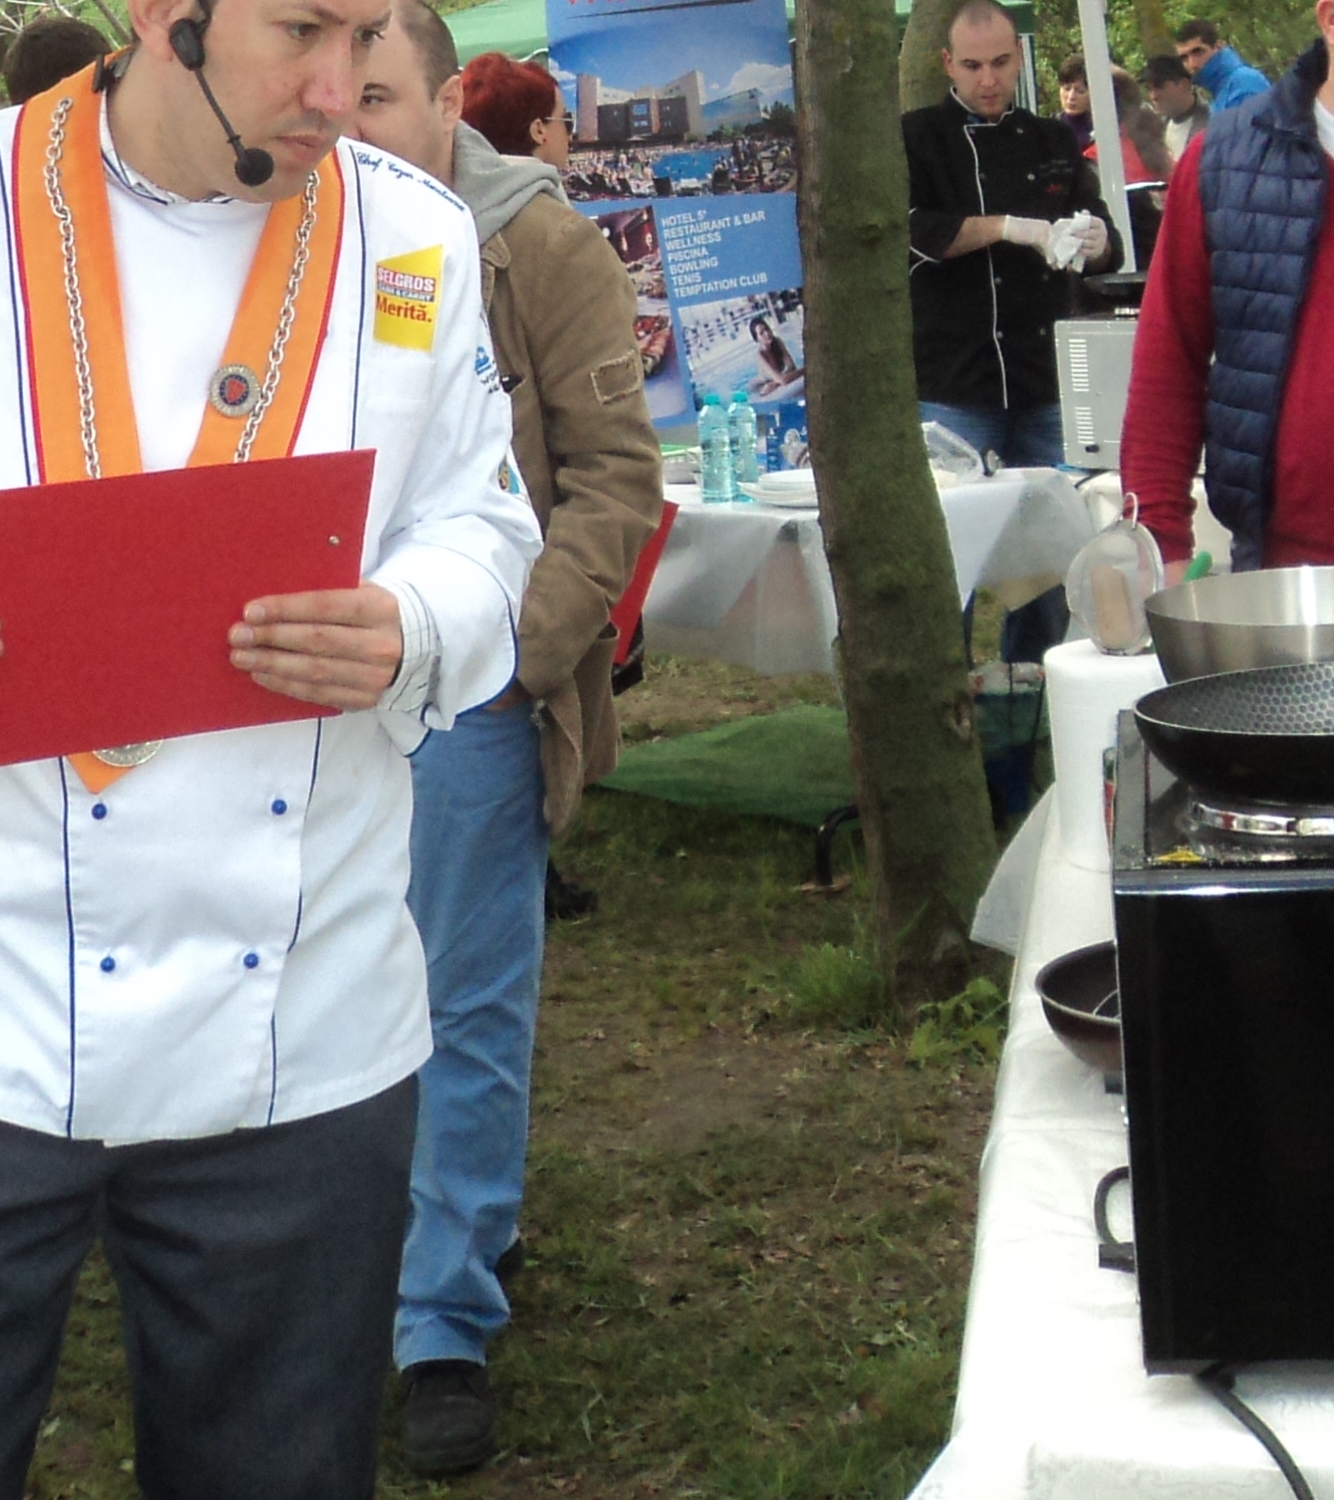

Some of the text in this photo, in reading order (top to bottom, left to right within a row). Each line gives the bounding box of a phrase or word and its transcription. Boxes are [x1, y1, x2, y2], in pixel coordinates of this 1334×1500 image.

[661, 212, 695, 227] HOTEL
[663, 210, 766, 239] RESTAURANT & BAR
[665, 231, 722, 251] WELLNESS
[667, 246, 708, 263] PISCINA
[669, 256, 718, 275] BOWLING
[377, 266, 435, 292] SELGROS
[671, 272, 702, 286] TENIS
[673, 272, 768, 298] TEMPTATION CLUB
[375, 293, 432, 322] Merită.
